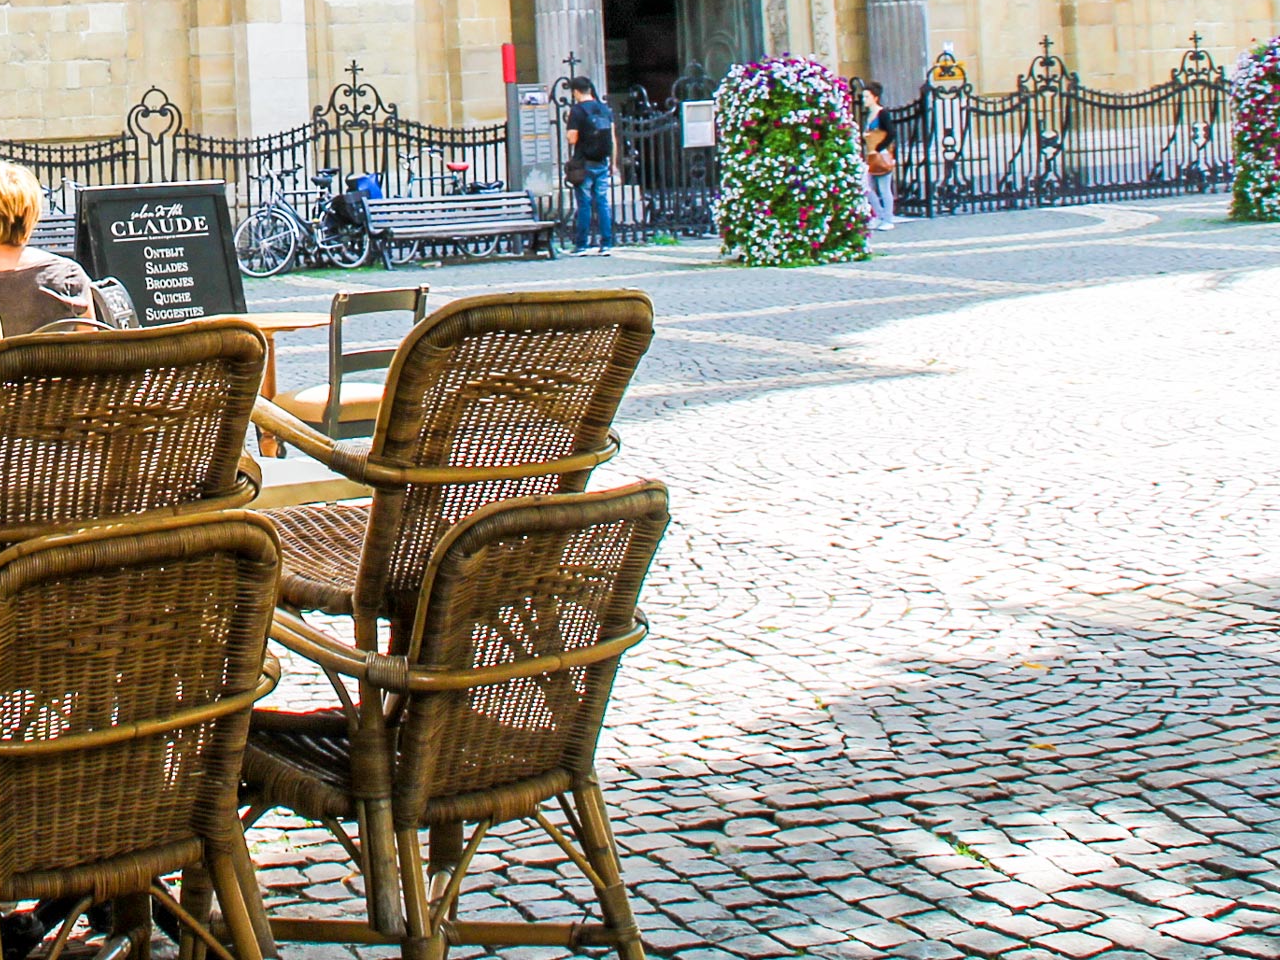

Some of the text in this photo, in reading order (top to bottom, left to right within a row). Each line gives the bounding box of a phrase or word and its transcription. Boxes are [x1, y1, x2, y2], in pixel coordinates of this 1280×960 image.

[111, 215, 209, 236] CLAUDE
[145, 262, 189, 275] SALADES
[145, 277, 194, 290] BROODJES
[154, 292, 192, 305] QUICHE
[145, 306, 204, 321] SUGGESTIES
